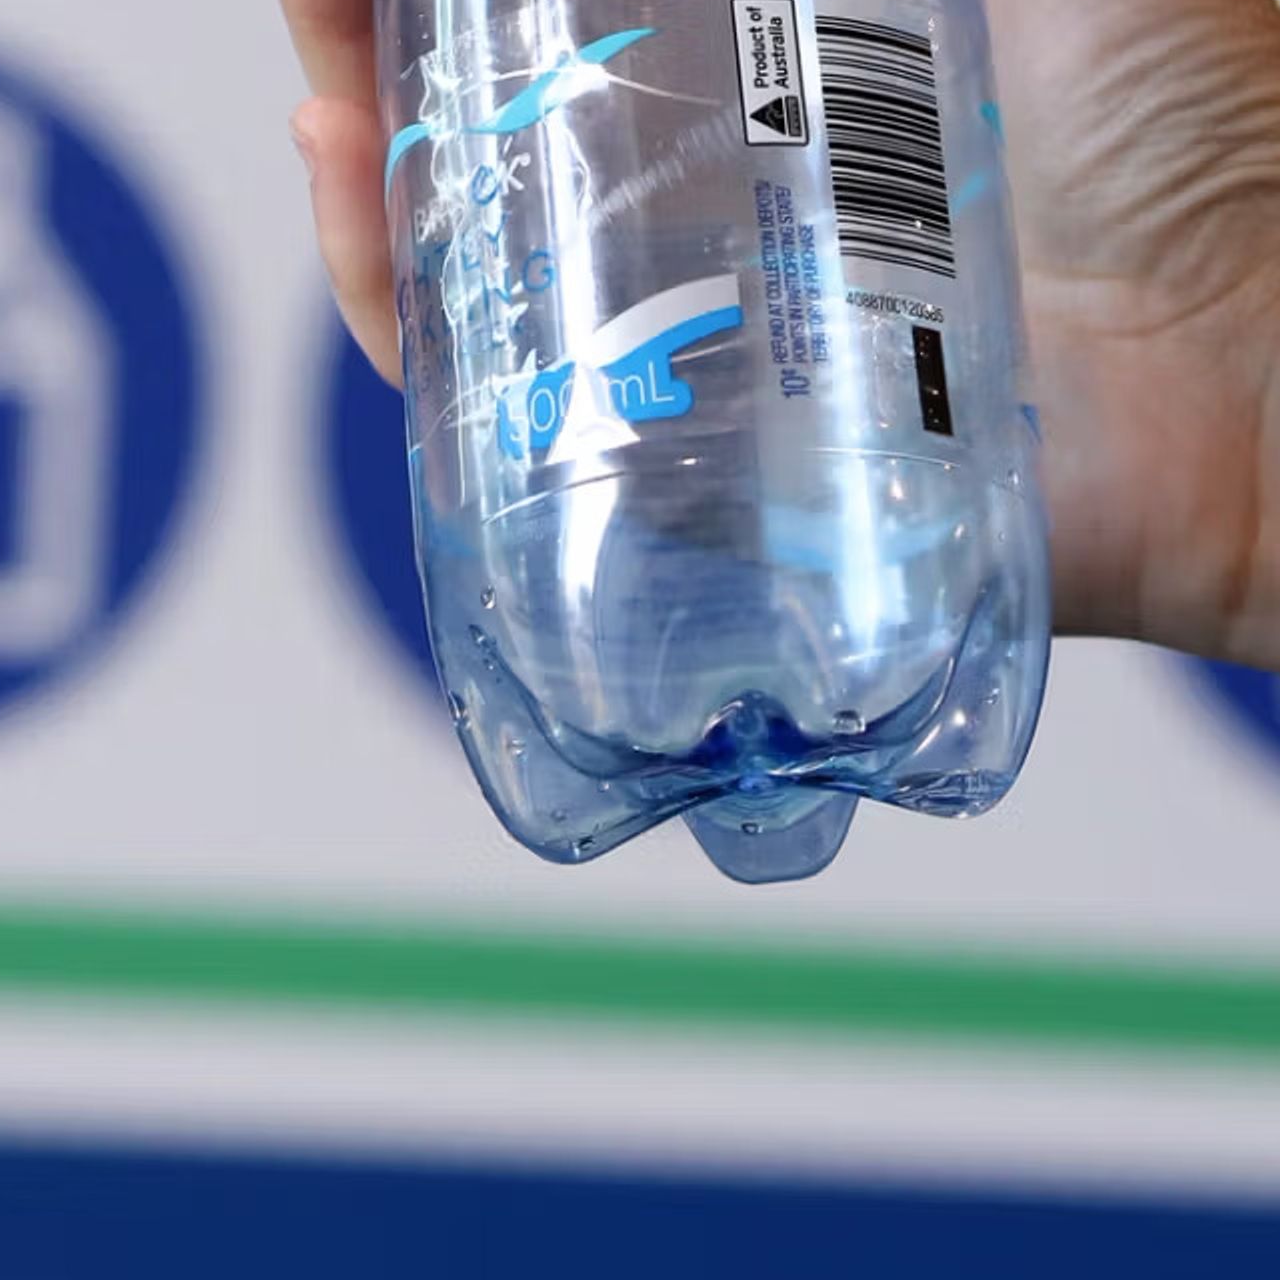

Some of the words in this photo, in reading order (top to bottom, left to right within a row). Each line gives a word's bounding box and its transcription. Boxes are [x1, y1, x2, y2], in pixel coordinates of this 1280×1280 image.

[744, 6, 761, 22] of
[748, 26, 769, 89] Product
[767, 16, 790, 89] Australia
[760, 231, 782, 300] COLLECTION
[778, 227, 802, 306] PARTICIPATING
[767, 301, 783, 317] AT
[788, 307, 804, 321] IN
[770, 318, 789, 364] REFUND
[789, 322, 809, 364] POINTS
